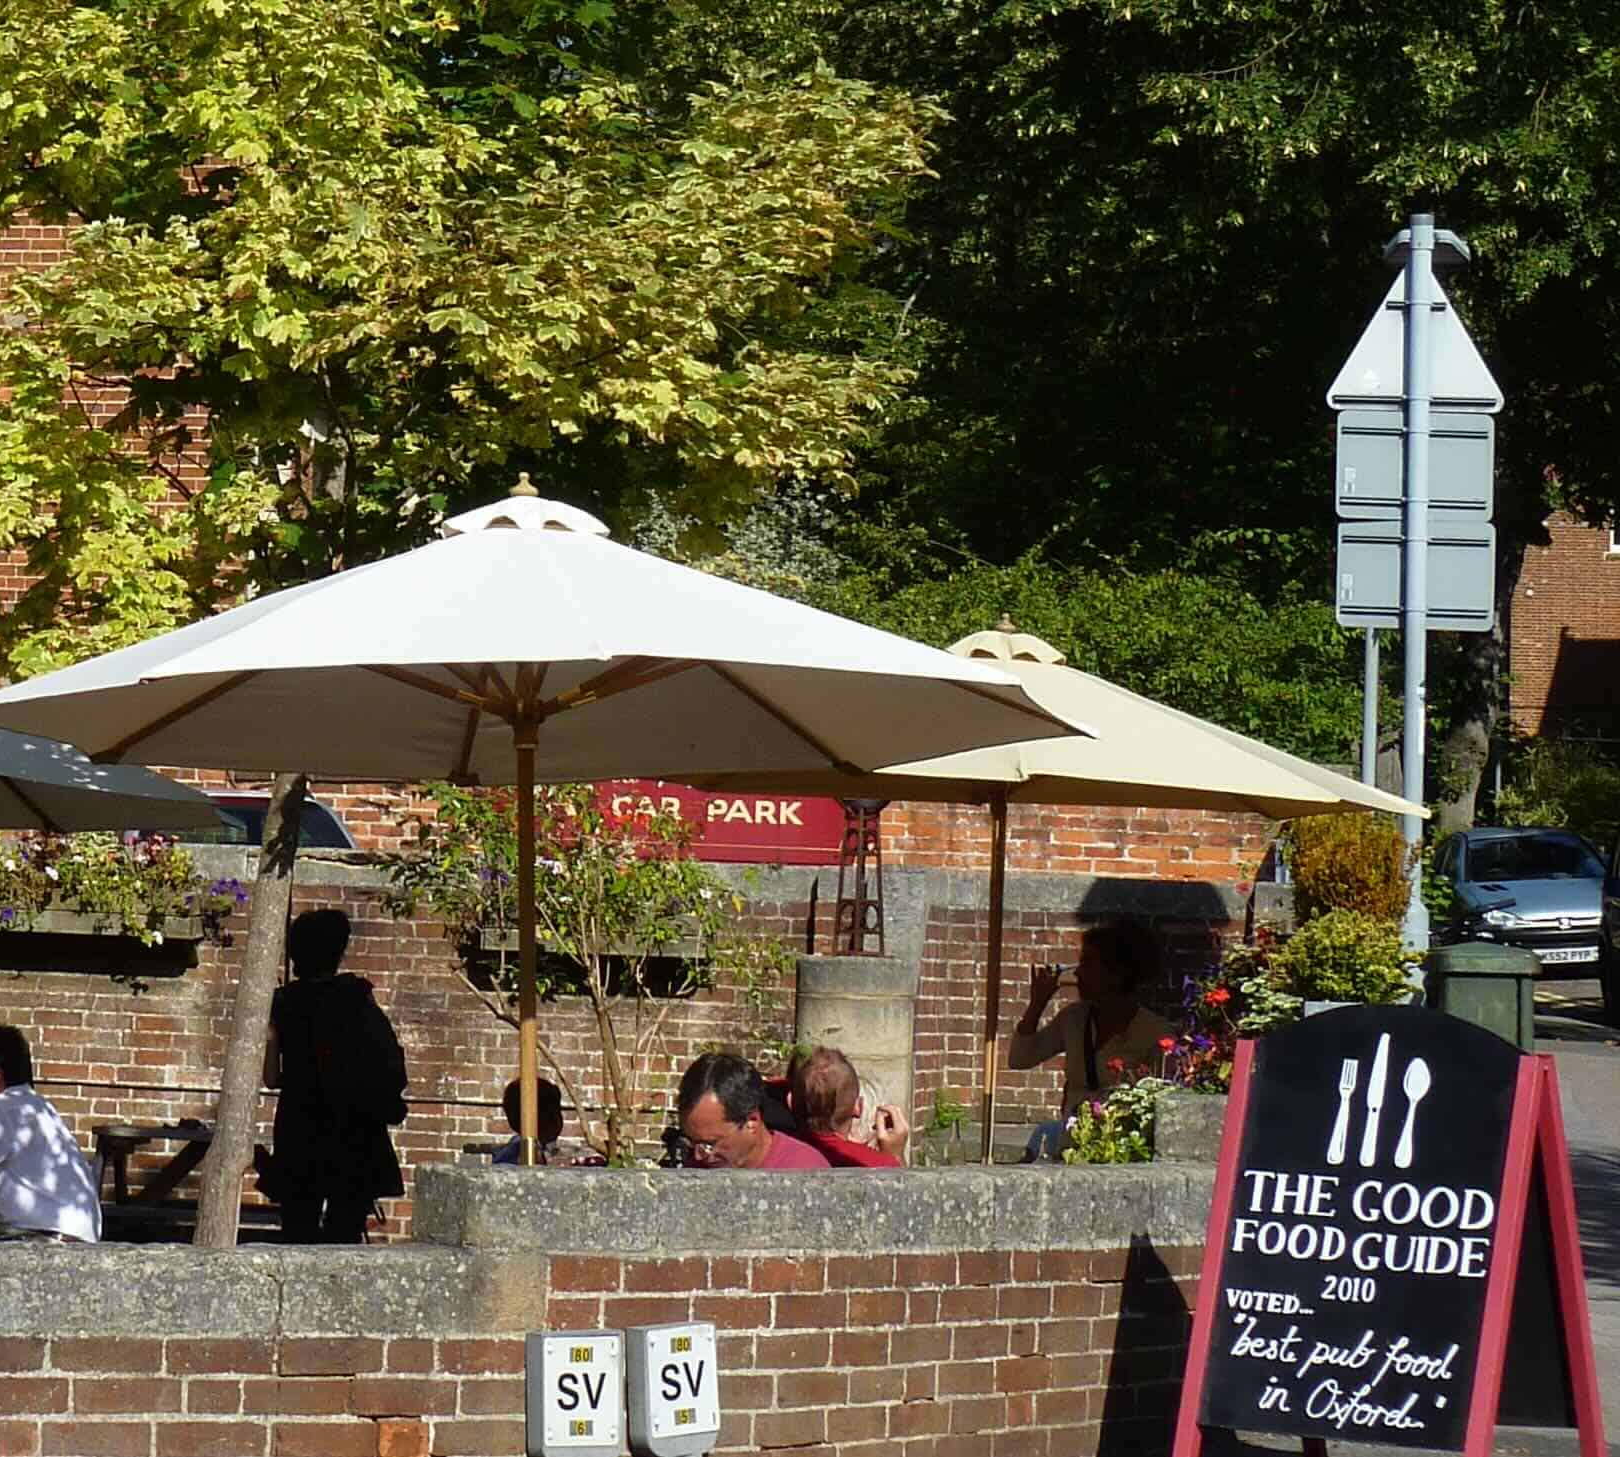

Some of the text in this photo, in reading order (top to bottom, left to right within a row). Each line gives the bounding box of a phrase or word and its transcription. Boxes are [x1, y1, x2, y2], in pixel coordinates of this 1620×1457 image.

[612, 794, 804, 825] CAR PARK
[1244, 1169, 1495, 1231] THE GOOD
[1232, 1218, 1492, 1279] FOOD GUIDE
[1320, 1275, 1377, 1303] 2010
[676, 1336, 691, 1353] 80
[1296, 1329, 1377, 1379] pub
[1372, 1336, 1460, 1387] food
[557, 1372, 607, 1411] SV
[661, 1359, 705, 1402] SV
[1258, 1376, 1292, 1413] in
